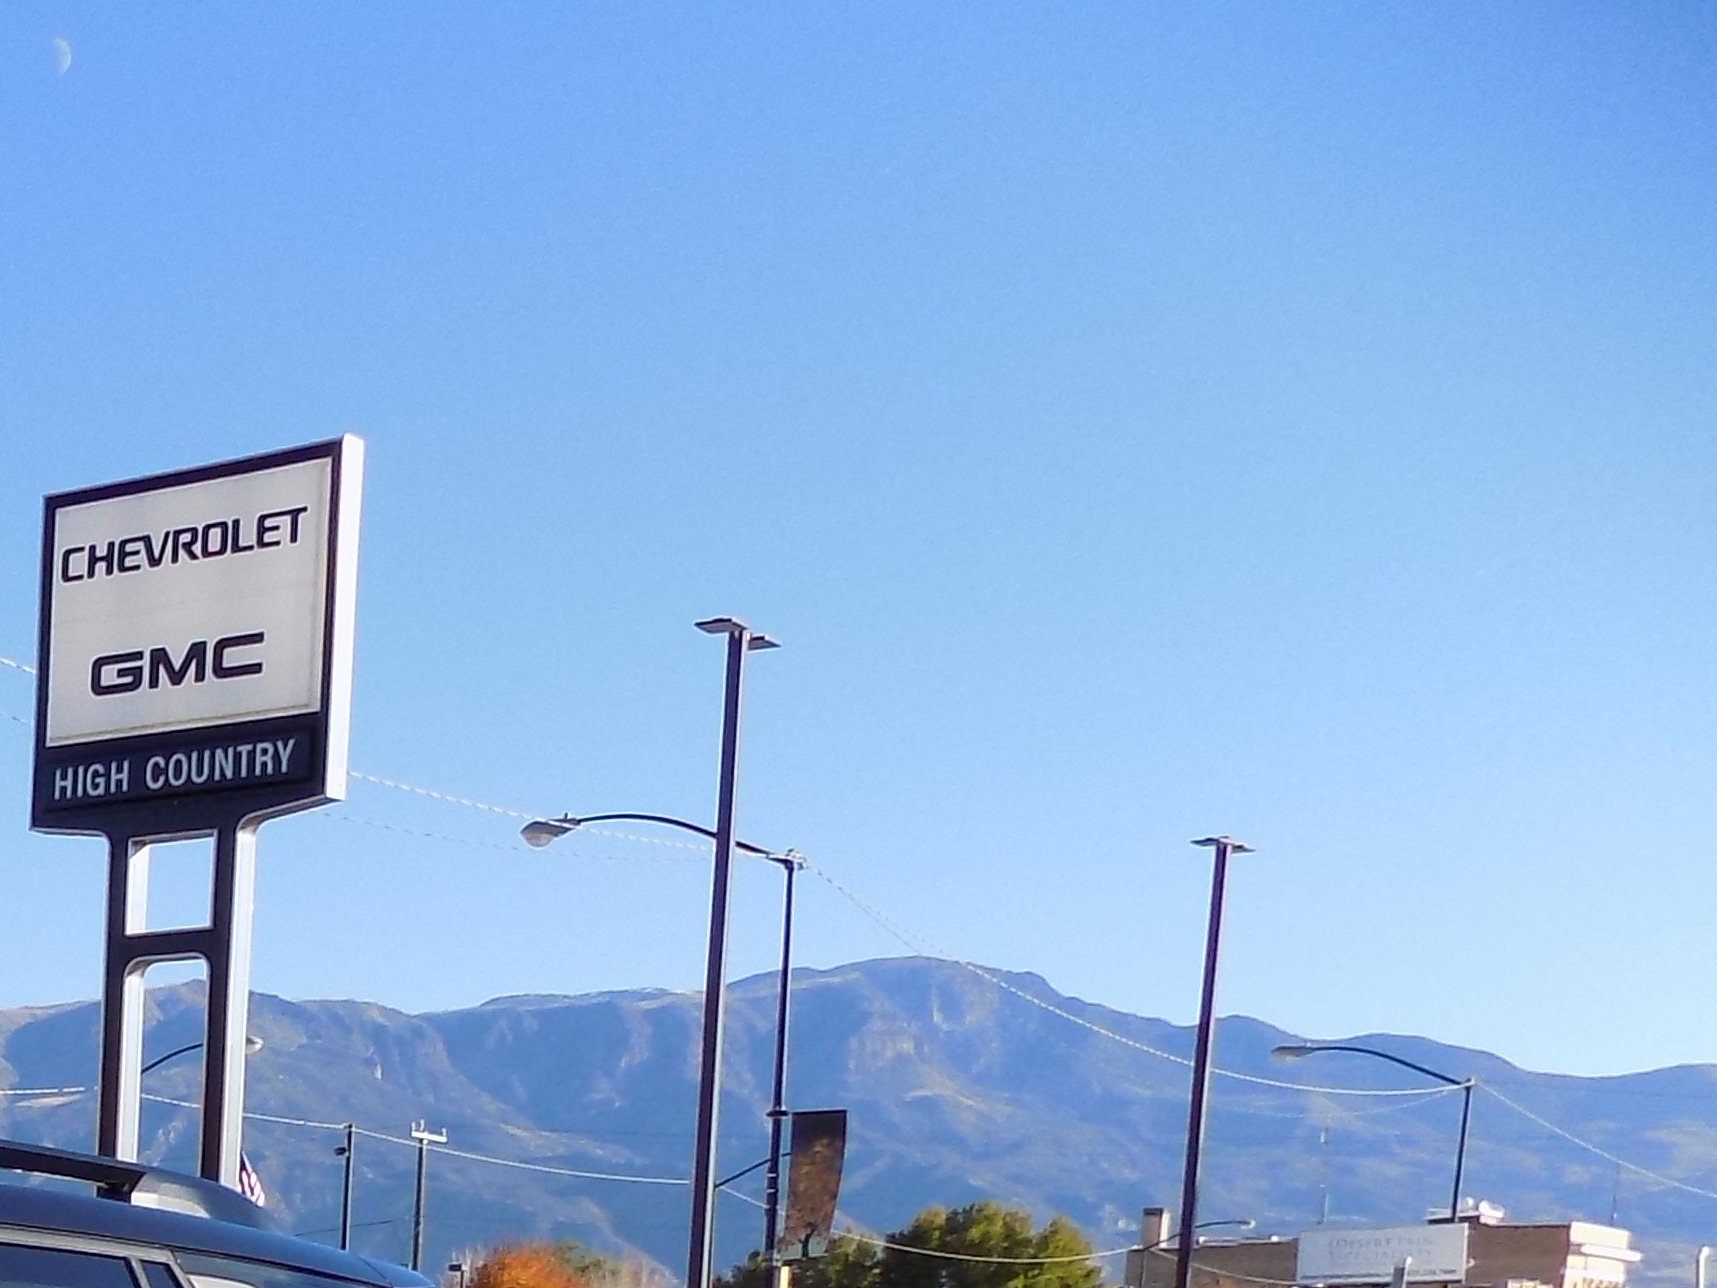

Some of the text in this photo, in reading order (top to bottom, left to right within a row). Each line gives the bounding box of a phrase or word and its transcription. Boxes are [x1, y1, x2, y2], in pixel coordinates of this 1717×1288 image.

[60, 505, 309, 584] CHEVROLET
[91, 631, 265, 696] GMC
[54, 738, 296, 800] HIGH COUNTRY
